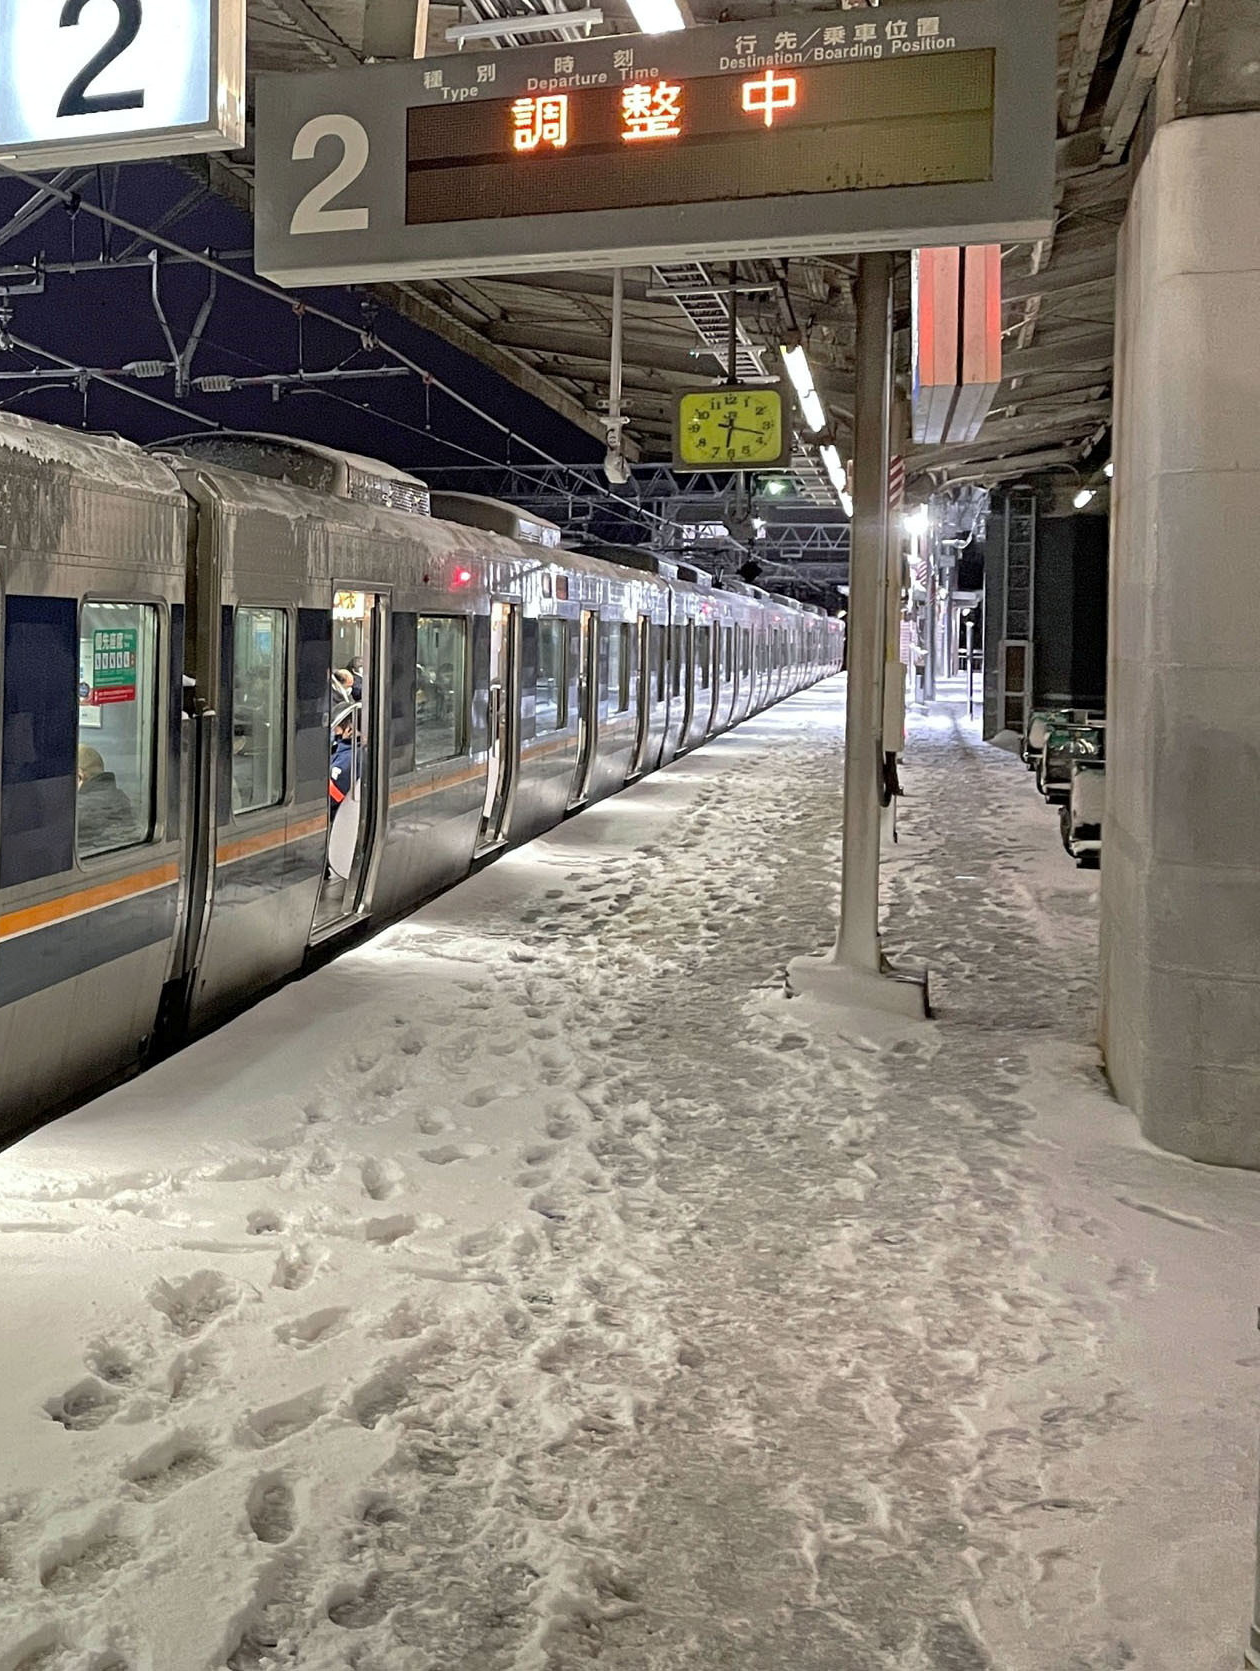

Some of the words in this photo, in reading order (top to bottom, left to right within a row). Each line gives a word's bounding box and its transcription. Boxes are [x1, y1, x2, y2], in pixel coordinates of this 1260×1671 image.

[720, 43, 882, 70] Destination/Boarding
[891, 35, 956, 54] Position
[56, 0, 144, 117] 2
[527, 72, 607, 92] Departure
[619, 66, 659, 80] Time
[441, 85, 478, 100] Type
[289, 114, 370, 235] 2
[710, 400, 721, 410] 11
[724, 396, 738, 405] 12
[698, 411, 710, 420] 10
[755, 407, 764, 415] 2
[692, 423, 700, 433] 9
[762, 421, 770, 430] 3
[699, 438, 706, 447] 8
[756, 436, 764, 444] 4
[712, 447, 720, 458] 7
[727, 449, 735, 458] 6
[742, 446, 750, 454] 5
